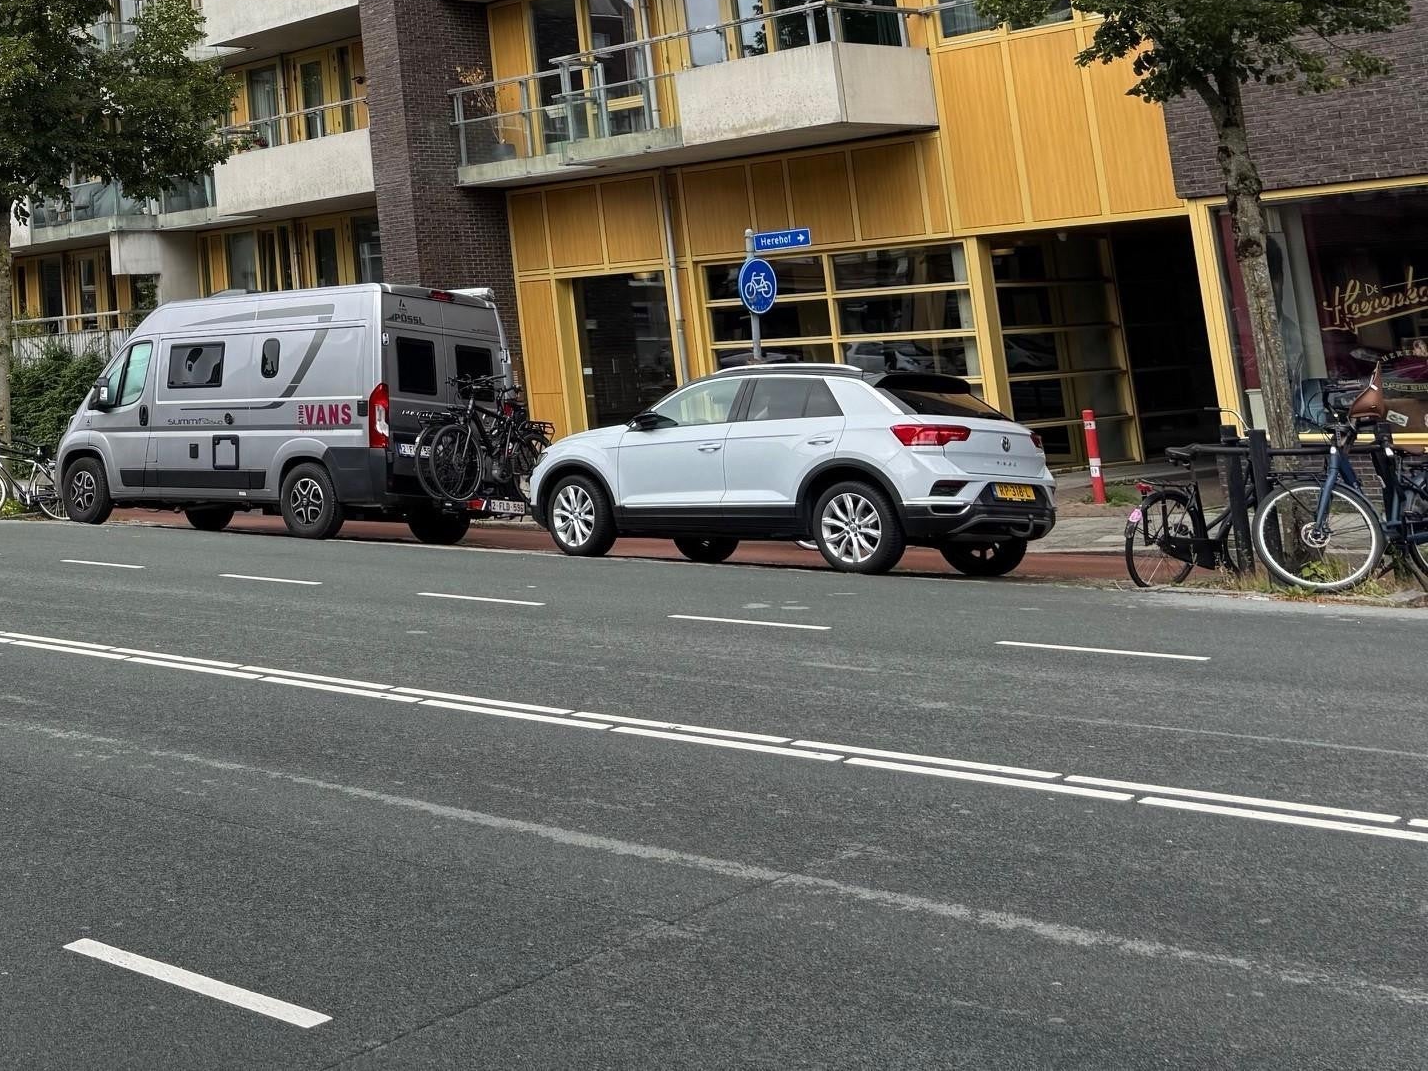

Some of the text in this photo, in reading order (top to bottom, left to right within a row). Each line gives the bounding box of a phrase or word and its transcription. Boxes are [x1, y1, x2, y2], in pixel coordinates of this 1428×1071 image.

[760, 235, 792, 247] Herehof
[305, 403, 352, 425] VANS
[998, 483, 1031, 498] RP-318-L
